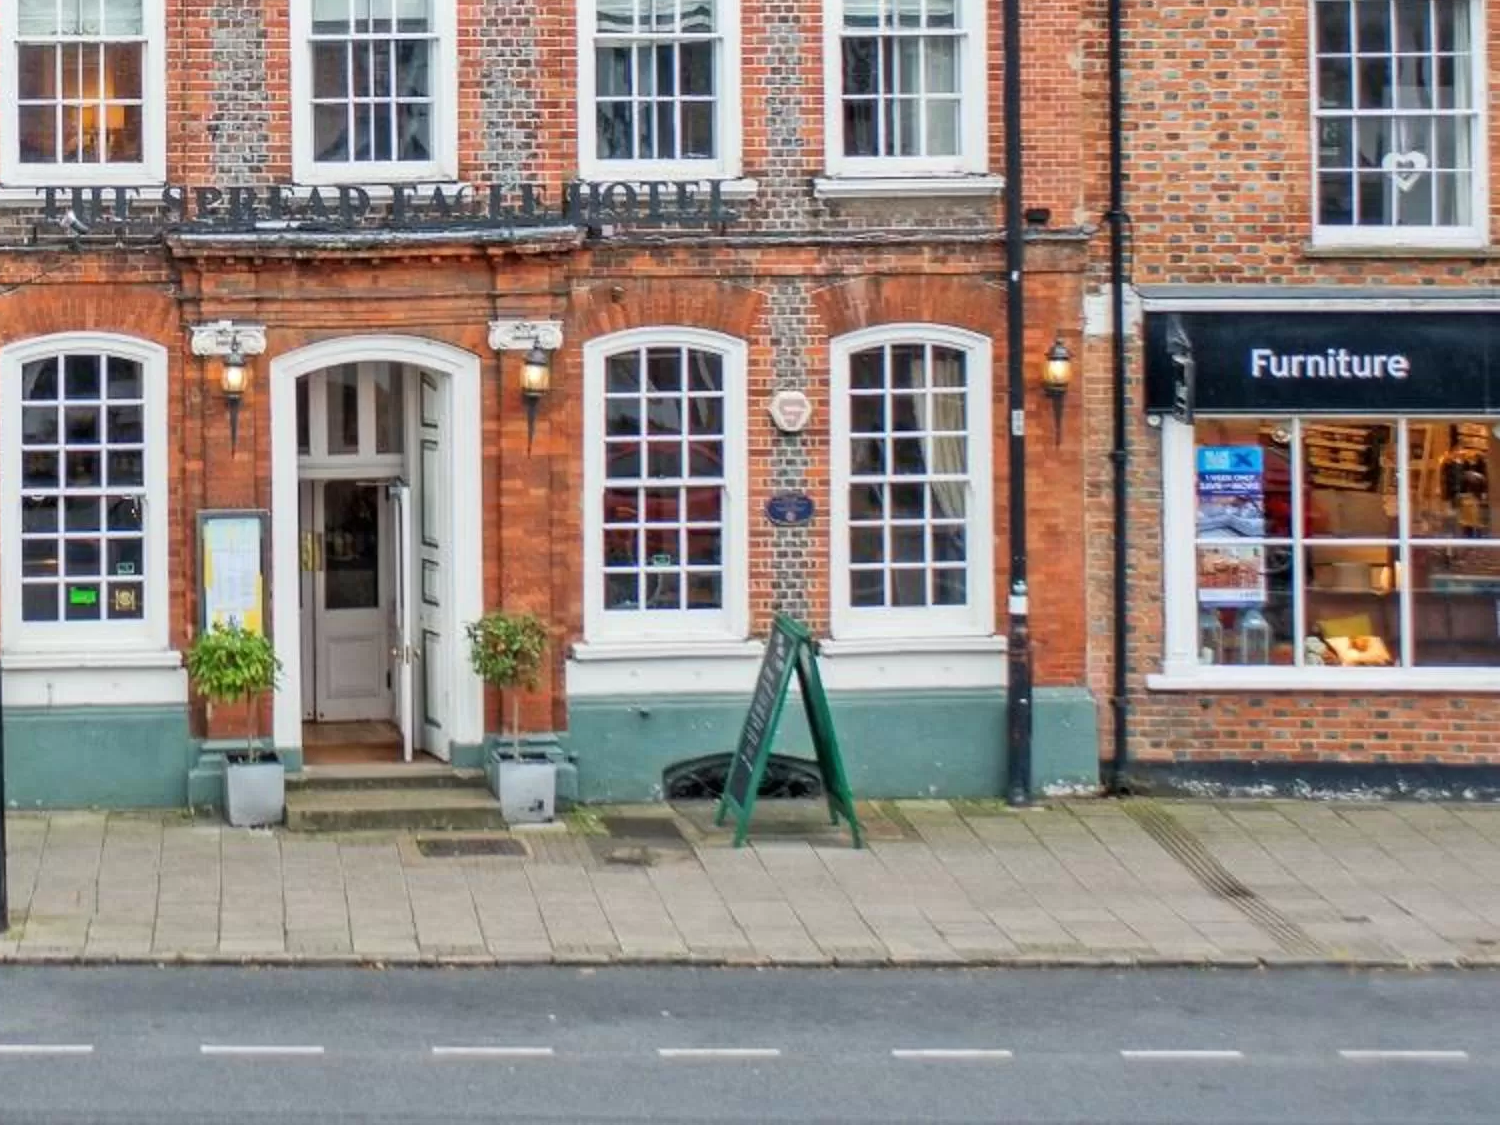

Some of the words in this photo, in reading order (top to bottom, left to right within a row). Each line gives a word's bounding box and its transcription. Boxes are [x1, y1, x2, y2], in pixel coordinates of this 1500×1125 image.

[35, 185, 141, 223] THE
[161, 183, 372, 223] SPREAD
[385, 182, 558, 224] EAGLE
[566, 179, 740, 224] HOTEL
[1251, 348, 1411, 379] Furniture
